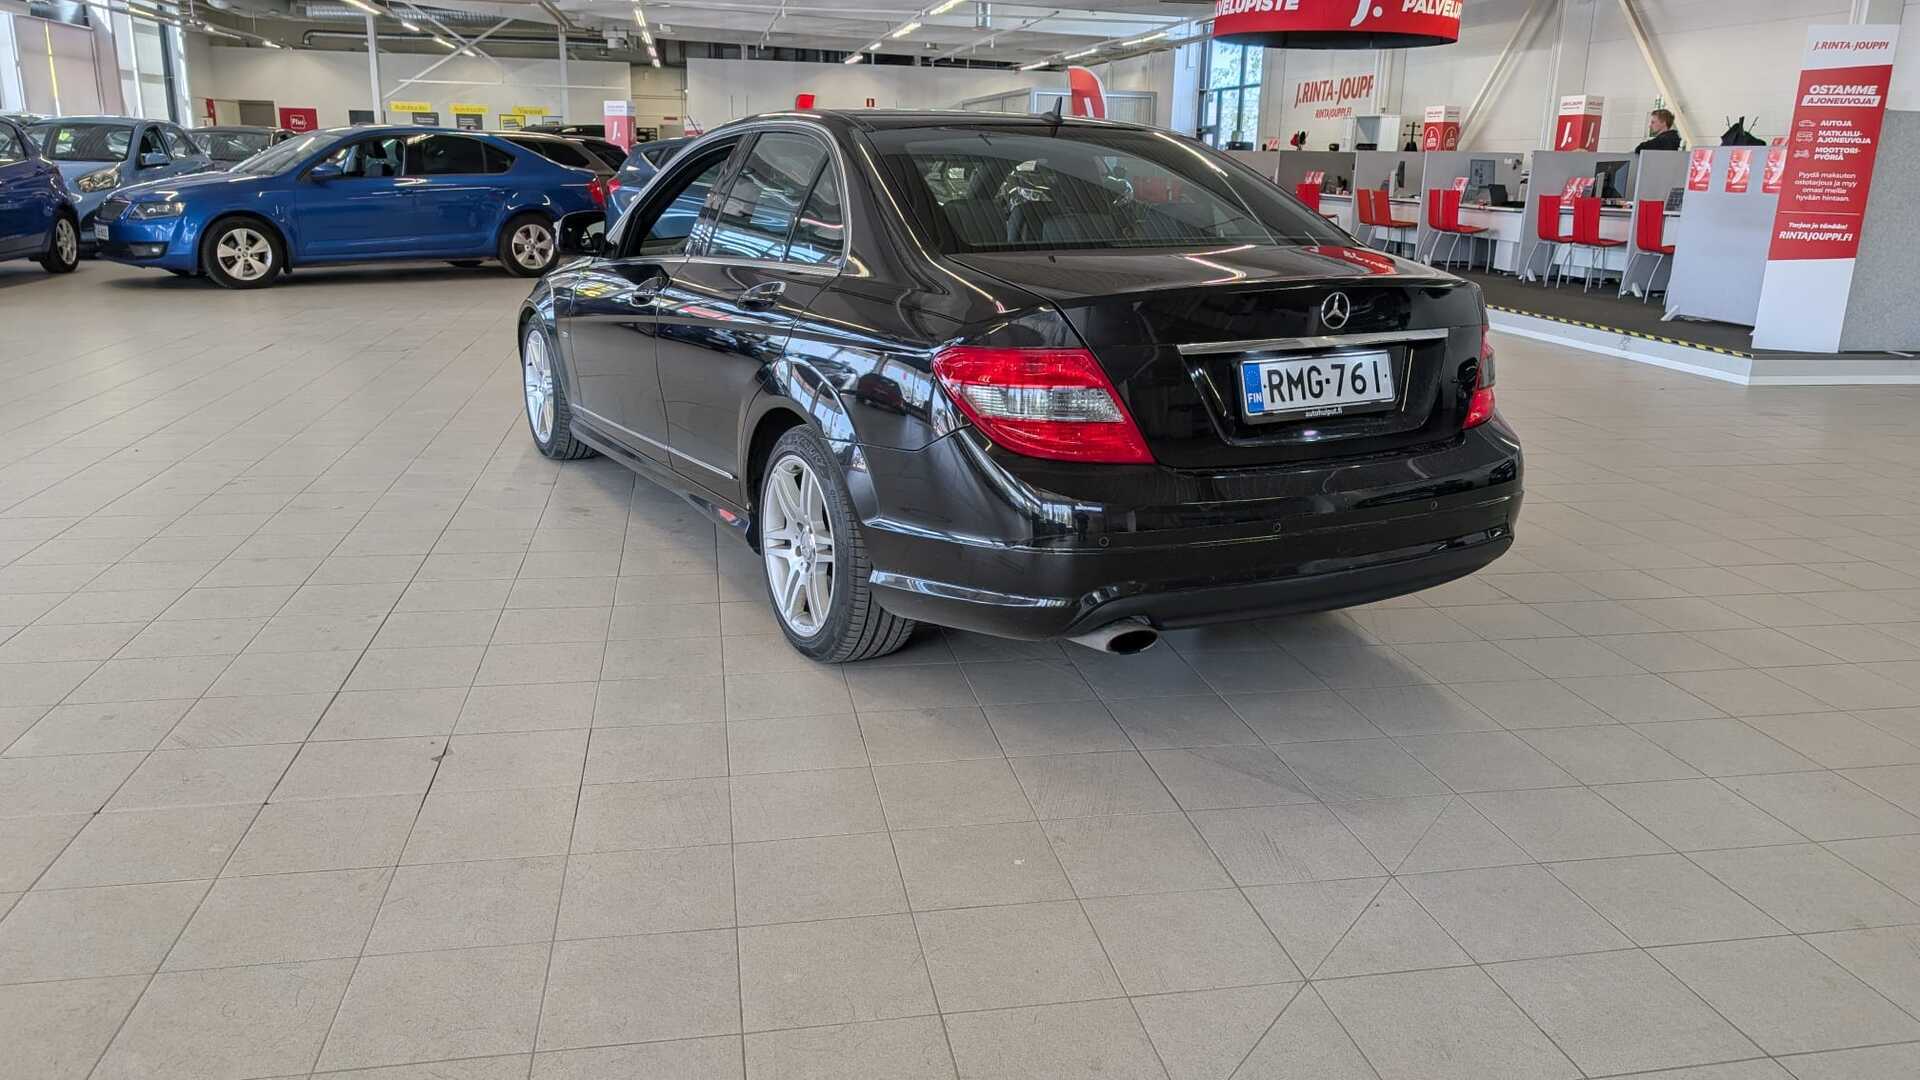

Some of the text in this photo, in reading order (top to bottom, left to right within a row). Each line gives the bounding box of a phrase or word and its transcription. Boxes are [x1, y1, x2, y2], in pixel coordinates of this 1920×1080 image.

[1216, 0, 1299, 17] VELUPISTE
[1813, 41, 1890, 51] J.RINTA-JOUPPI
[1294, 75, 1374, 109] J.RINTA-JOUPP
[1809, 85, 1878, 95] OSTAMME
[1807, 97, 1876, 105] AJONEUVOJA!
[1817, 136, 1871, 144] AJONEUVOJA
[1779, 231, 1853, 241] RINTAJOUPPI.FI
[1267, 360, 1381, 403] RMG-761
[1248, 392, 1263, 404] FIN
